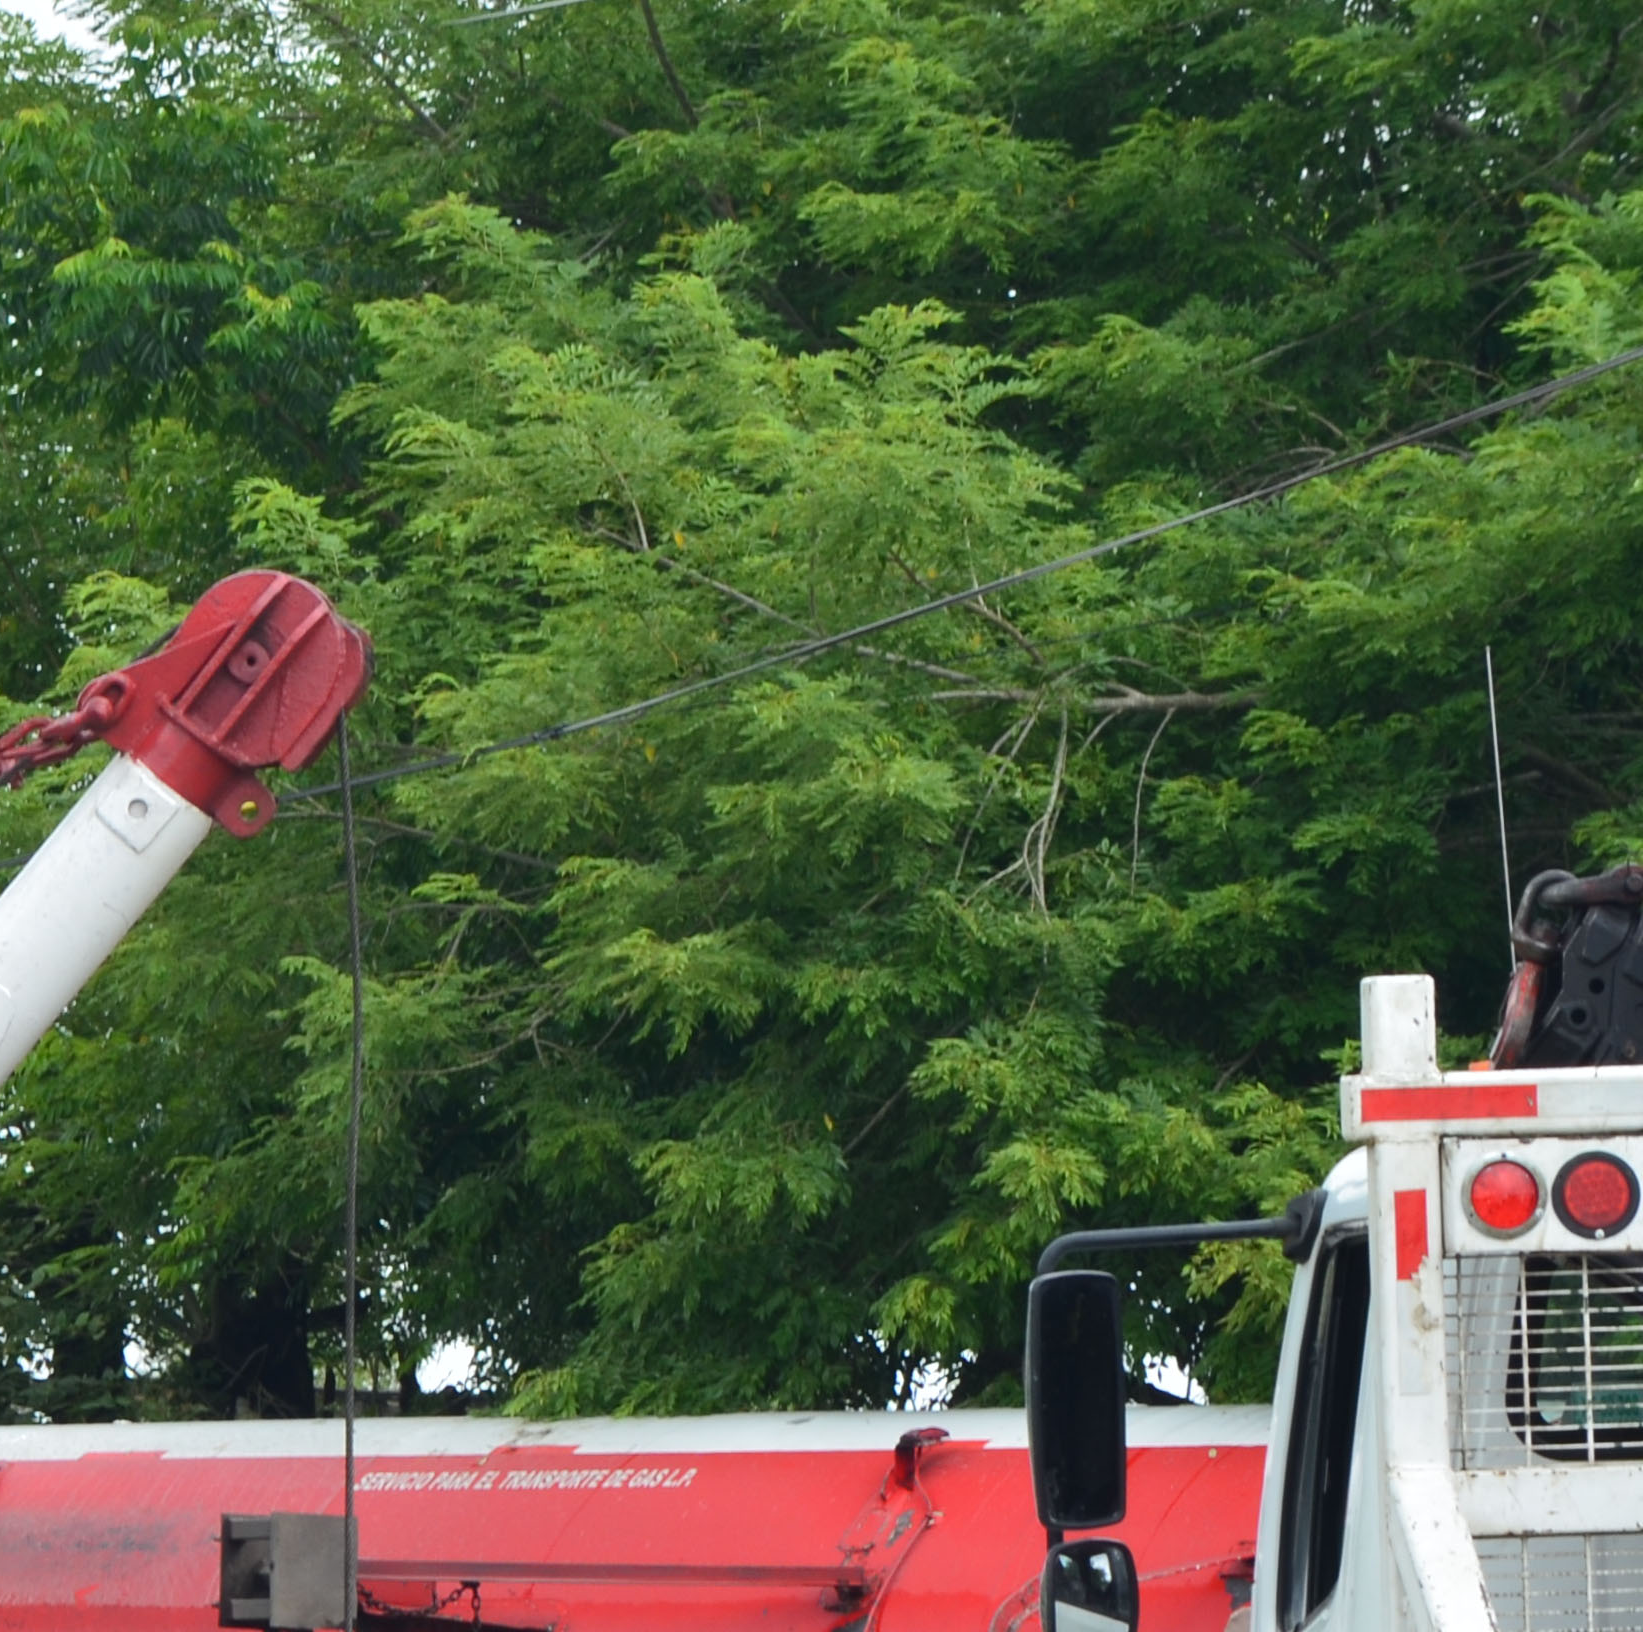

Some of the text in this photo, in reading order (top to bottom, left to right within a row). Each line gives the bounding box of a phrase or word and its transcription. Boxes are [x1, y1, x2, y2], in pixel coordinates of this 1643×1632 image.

[353, 1471, 435, 1492] SERVICIO
[428, 1471, 479, 1491] PARA
[473, 1470, 501, 1491] EL
[498, 1469, 611, 1490] TRANSPORTE
[602, 1468, 636, 1489] DE
[628, 1468, 671, 1489] GAS
